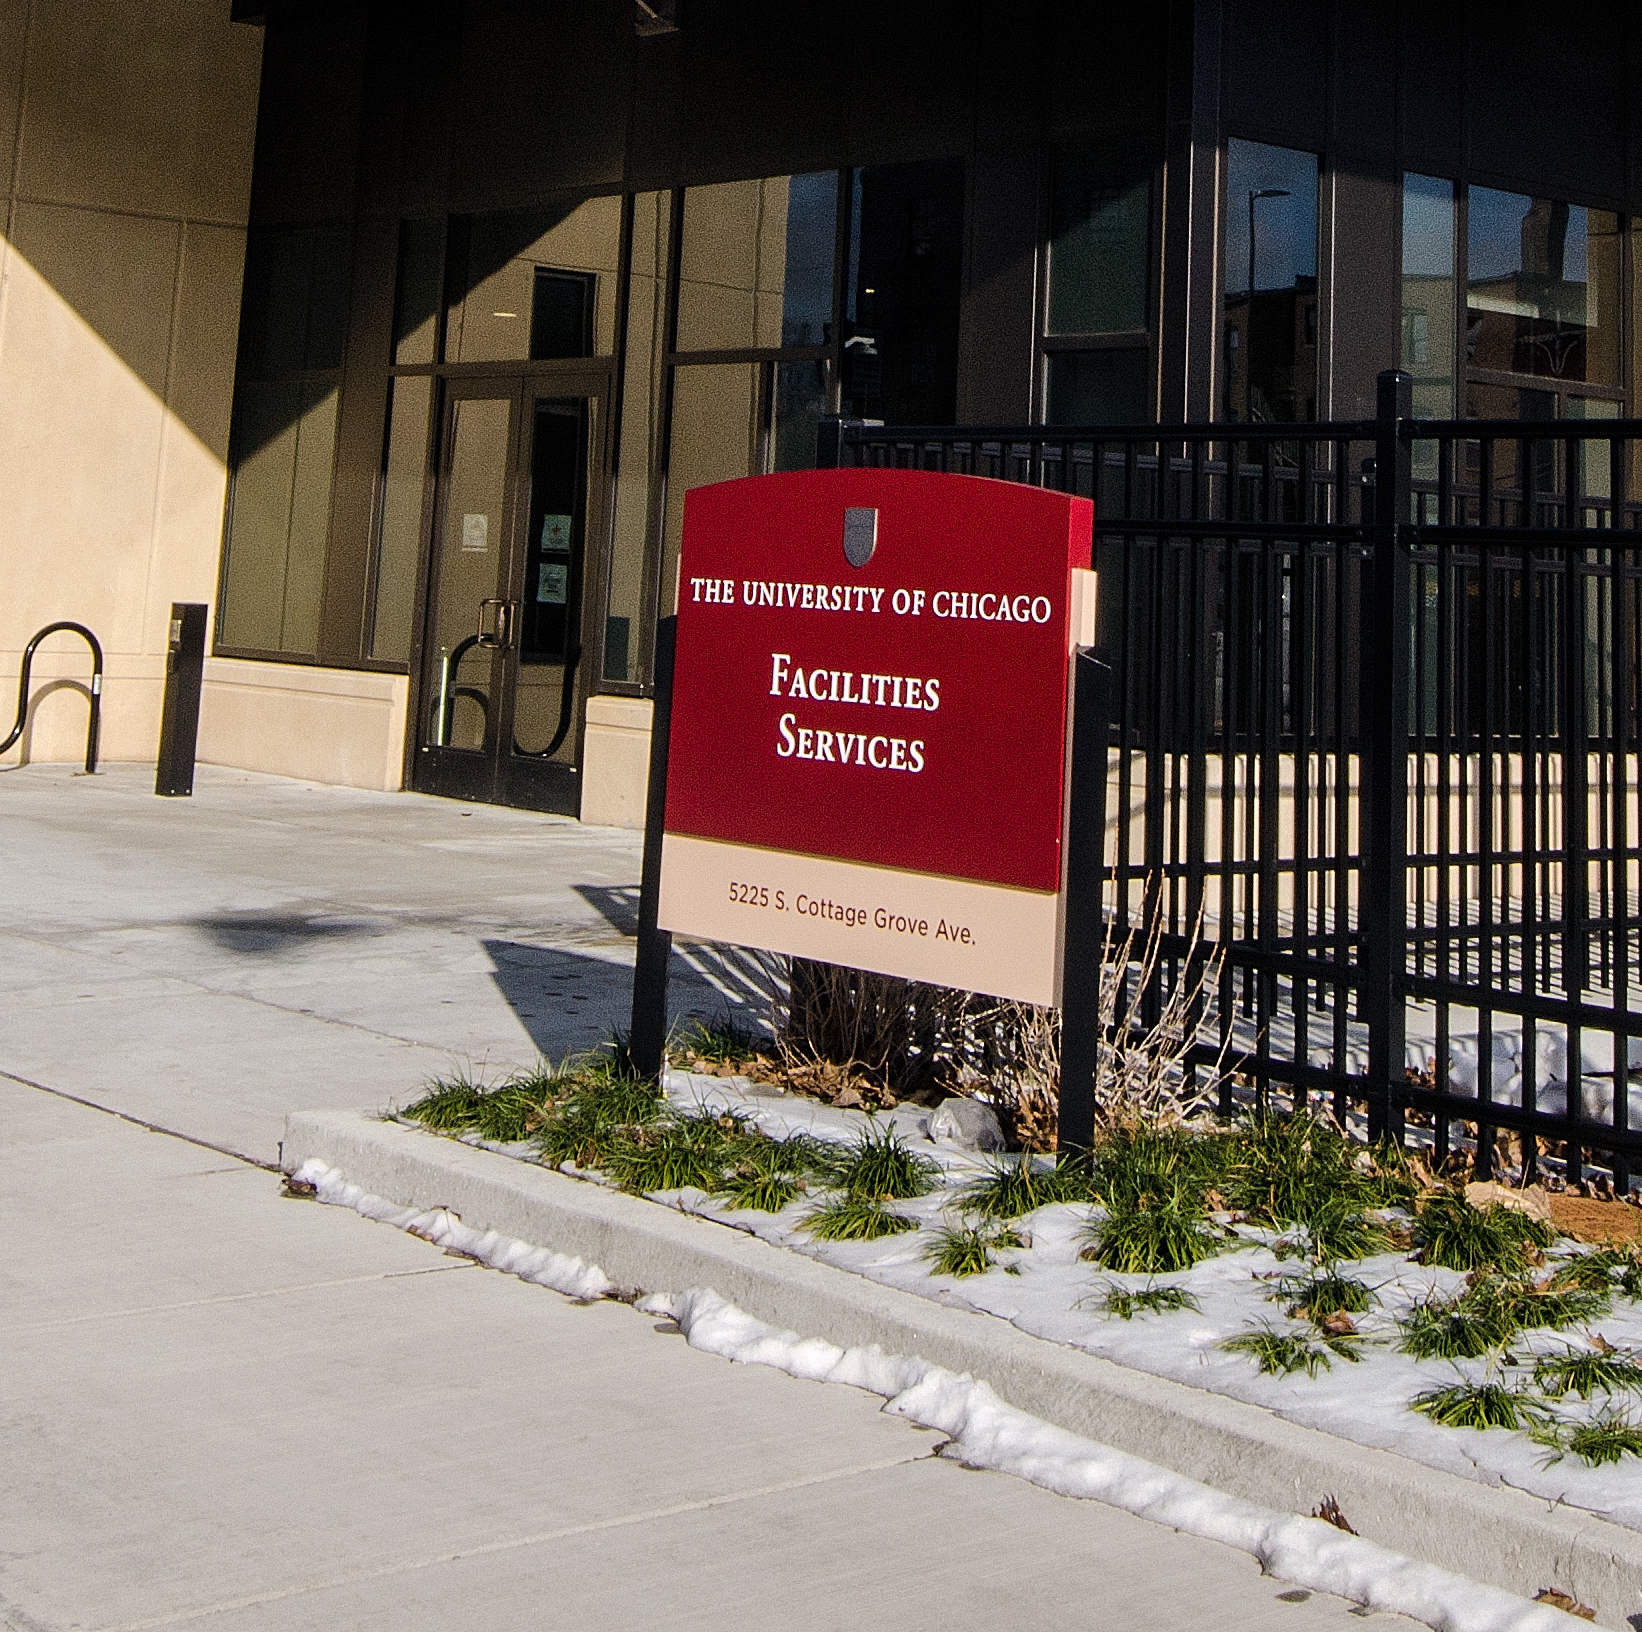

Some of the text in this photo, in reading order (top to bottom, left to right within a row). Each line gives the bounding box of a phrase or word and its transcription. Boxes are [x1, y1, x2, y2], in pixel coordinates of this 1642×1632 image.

[690, 578, 1052, 624] THE UNIVERSITY OF CHICAGO
[728, 881, 977, 946] 5225 S. Cottage Grove Ave.
